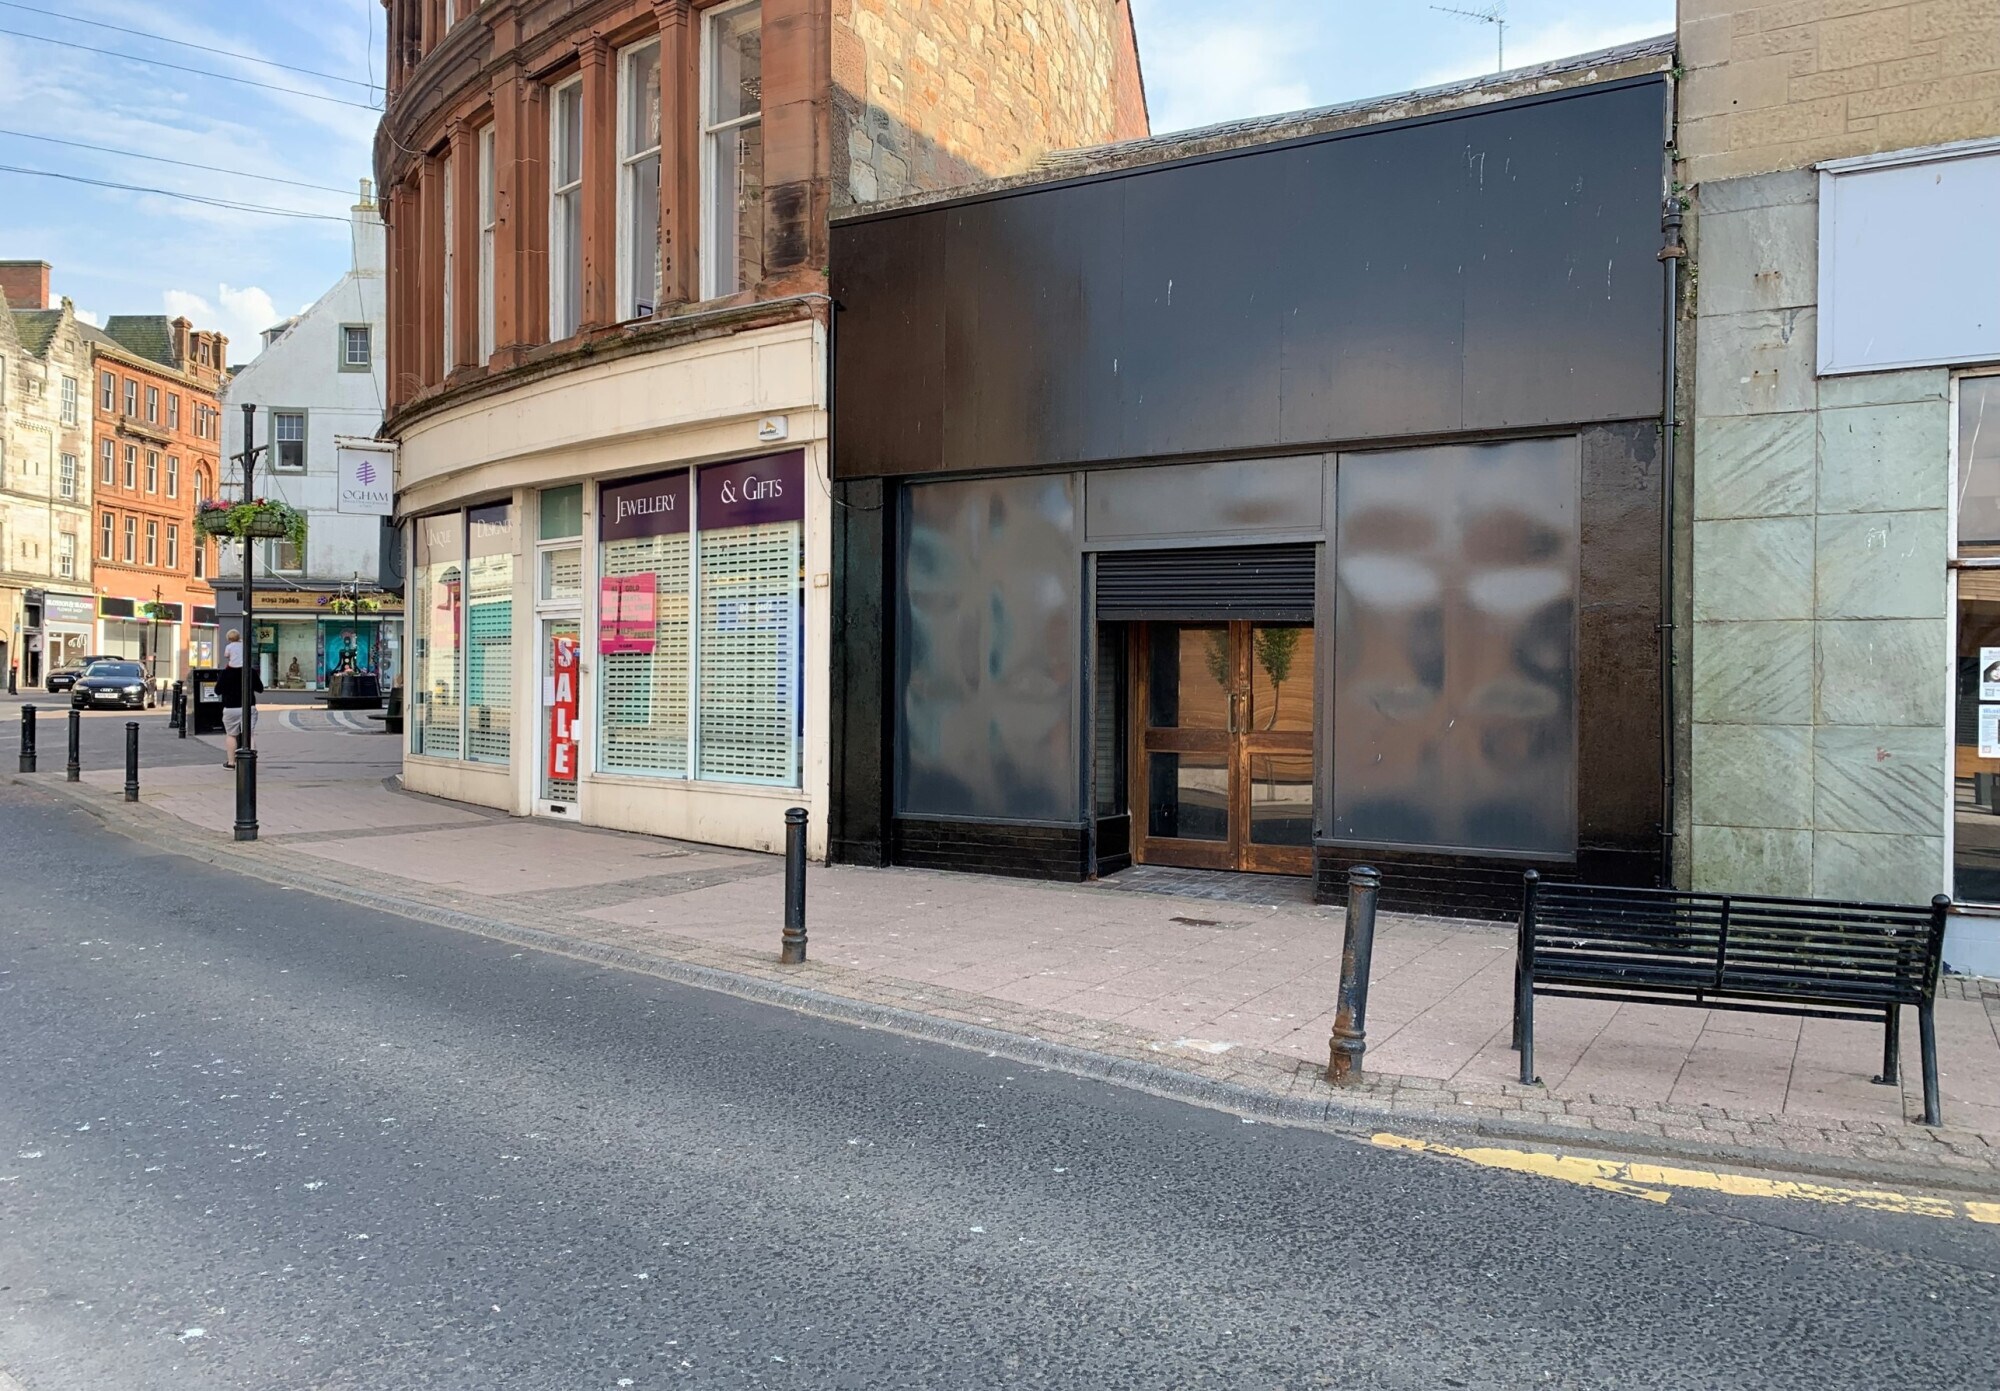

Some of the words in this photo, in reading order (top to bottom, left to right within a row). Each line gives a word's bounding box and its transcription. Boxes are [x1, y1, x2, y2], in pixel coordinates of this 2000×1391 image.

[342, 489, 389, 502] OGHAM
[615, 493, 676, 524] JEWELLERY
[720, 479, 738, 504] &
[743, 476, 783, 501] GIFTS
[427, 528, 453, 548] UNIQUE
[555, 636, 573, 774] SALE
